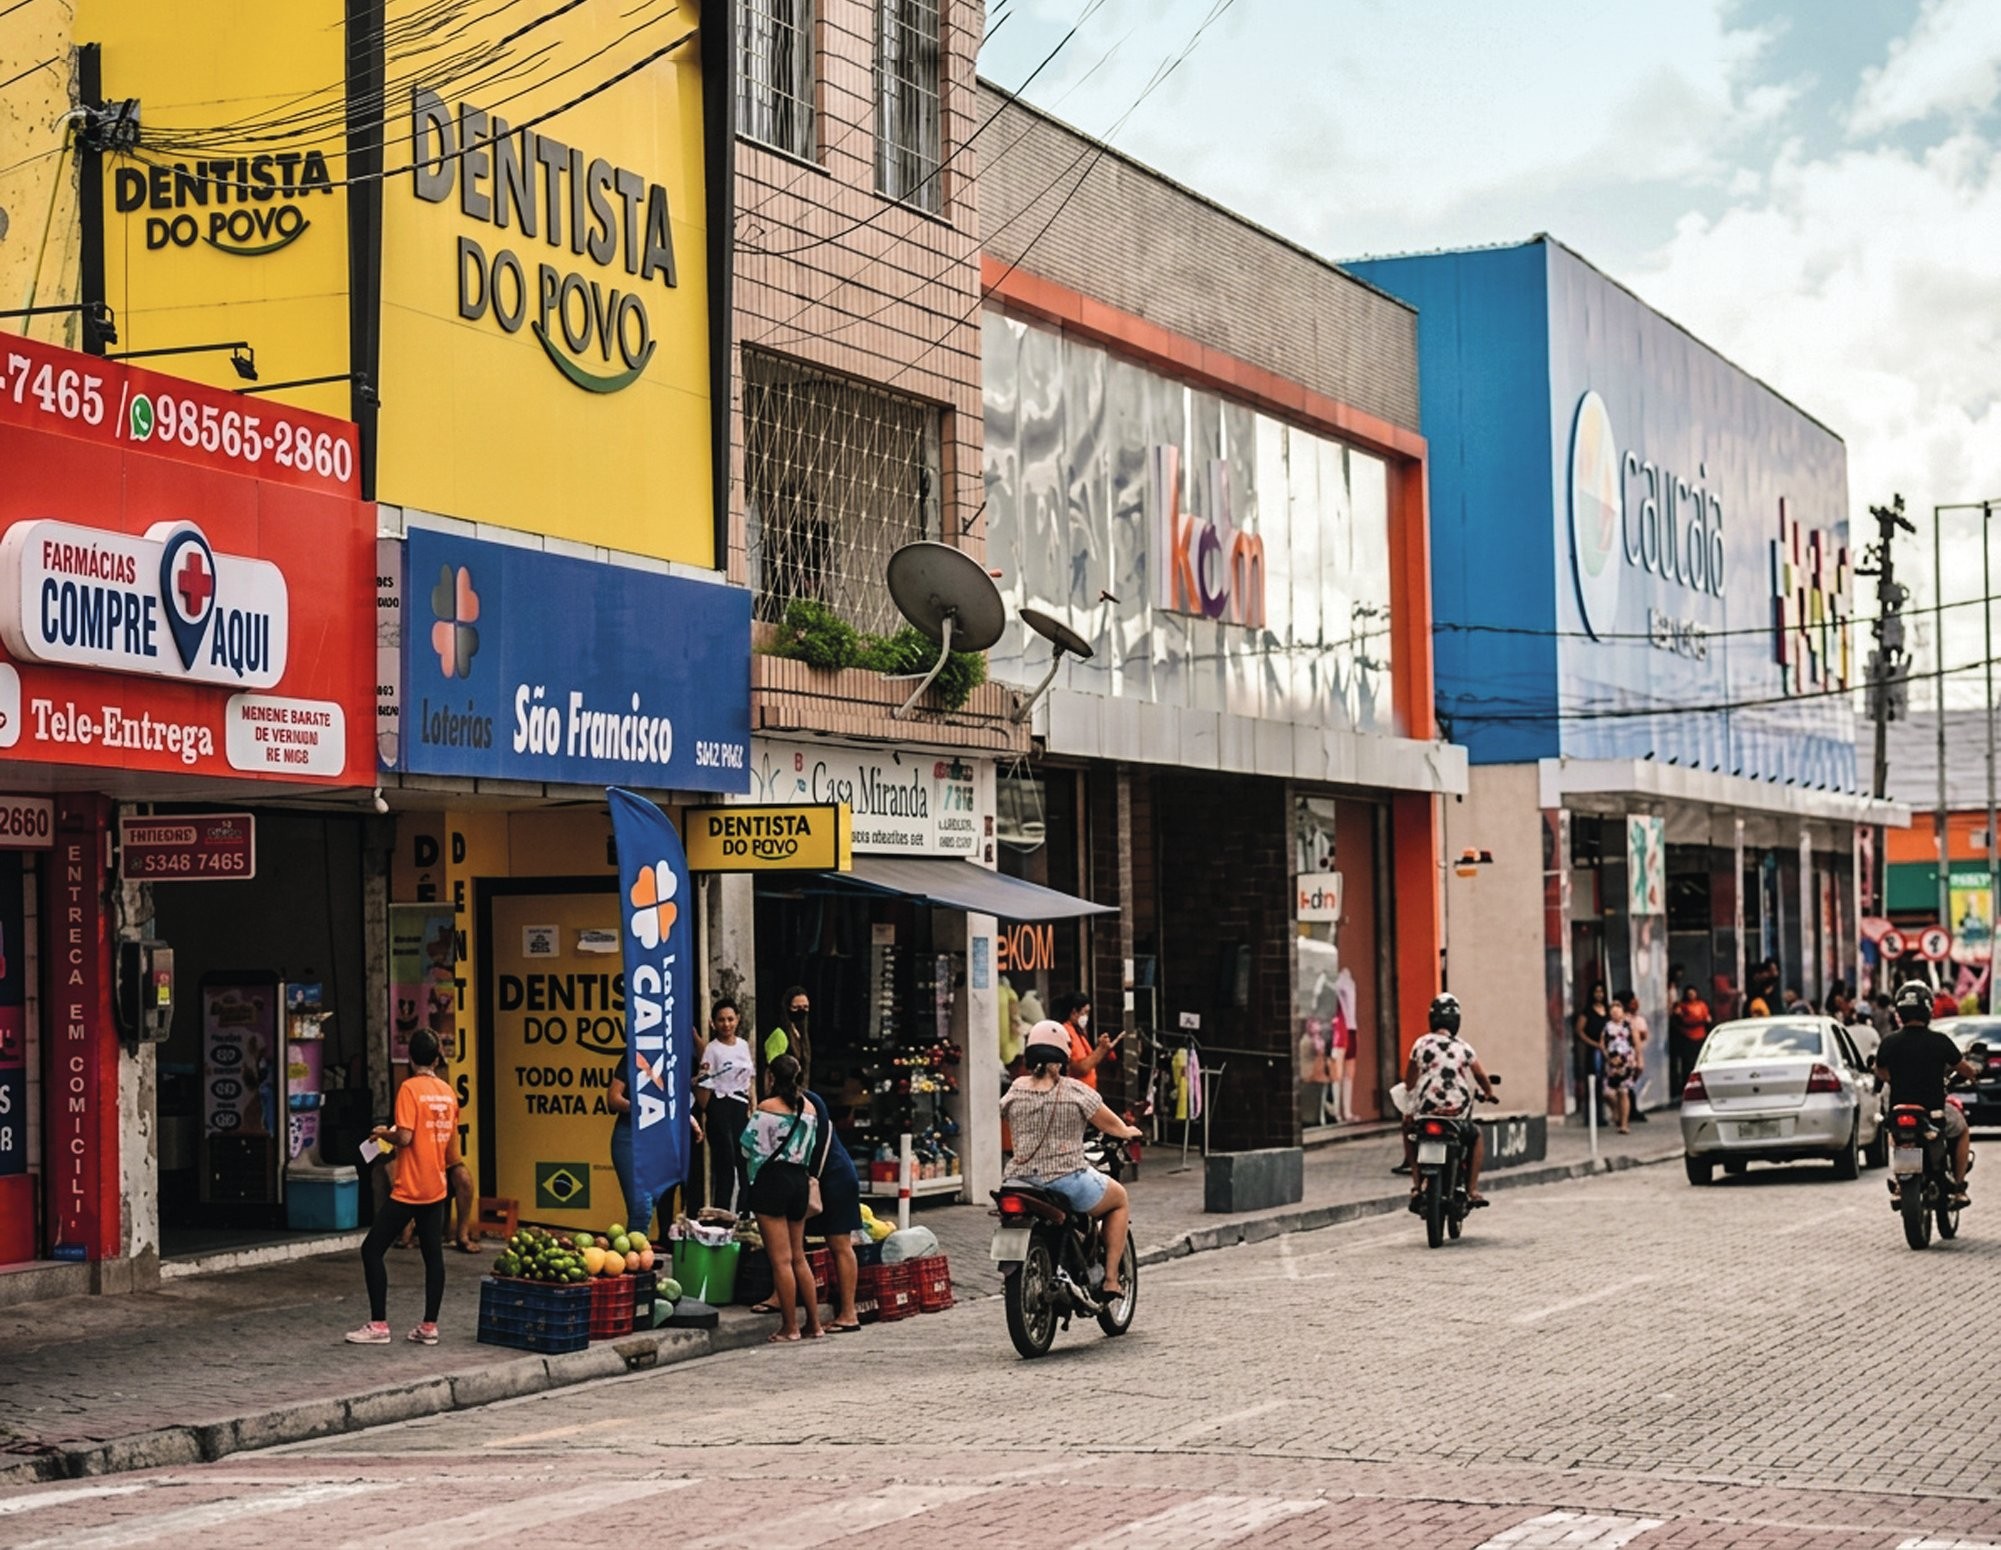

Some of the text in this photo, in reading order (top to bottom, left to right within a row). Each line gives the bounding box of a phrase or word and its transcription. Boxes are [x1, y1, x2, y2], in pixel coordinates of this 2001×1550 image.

[115, 150, 333, 213] DENTISTA
[410, 84, 677, 288] DENTISTA
[146, 205, 306, 250] DO POVO
[457, 235, 653, 376] DO POVO
[43, 540, 136, 585] FARMÁCIAS
[41, 577, 269, 678] COMPRE AQUI
[31, 699, 215, 764] Tele-Entrega
[513, 684, 673, 764] São Francisco
[812, 761, 928, 818] Casa Miranda
[708, 815, 811, 837] DENTISTA
[723, 840, 748, 856] DO
[197, 853, 244, 870] 7465
[68, 1004, 85, 1040] EM
[524, 1017, 567, 1045] DO
[632, 964, 666, 1131] CAIXA
[515, 1067, 573, 1087] TODO
[525, 1094, 587, 1115] TRATA
[68, 1056, 86, 1228] COMICILI
